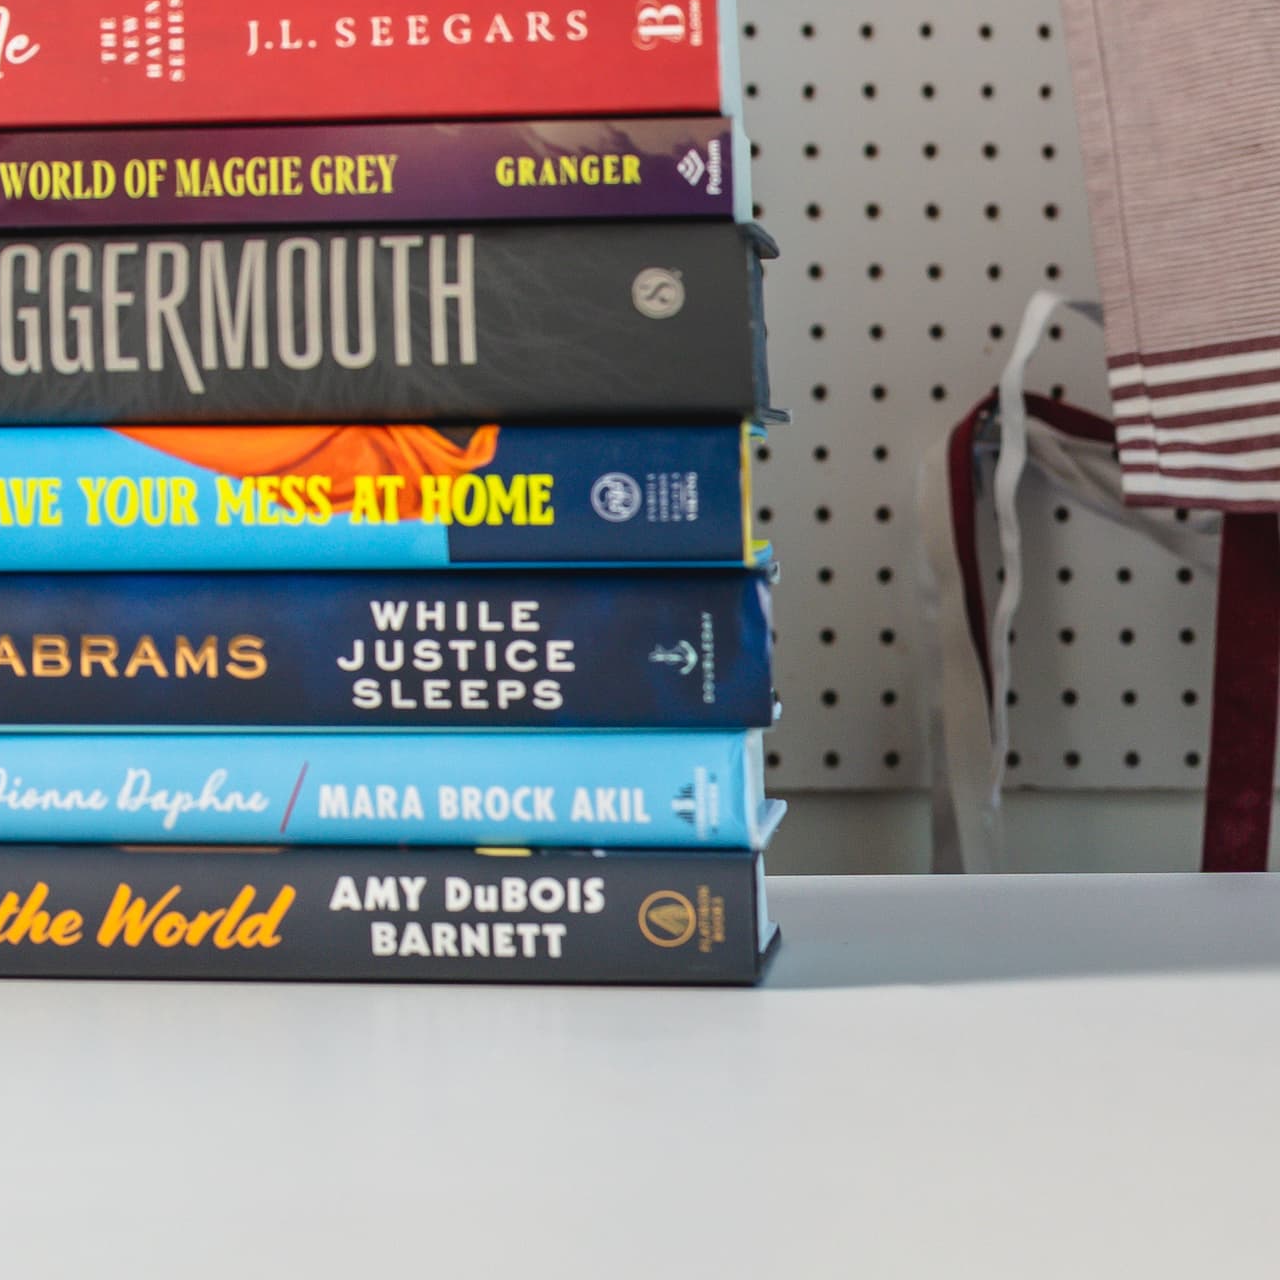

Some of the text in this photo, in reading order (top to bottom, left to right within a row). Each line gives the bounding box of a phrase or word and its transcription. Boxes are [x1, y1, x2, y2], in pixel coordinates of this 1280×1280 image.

[99, 17, 117, 64] THE
[122, 15, 140, 65] NEW
[144, 0, 163, 79] HAVEN
[246, 9, 590, 56] J.L. SEEGARS
[0, 159, 116, 201] WORLD
[123, 158, 168, 198] OF
[175, 156, 303, 198] MAGGIE
[309, 153, 399, 195] GREY
[494, 154, 642, 188] GRANGER
[706, 139, 722, 195] Podium
[78, 477, 200, 527] YOUR
[215, 475, 334, 525] MESS
[350, 473, 406, 524] AT
[420, 472, 555, 526] HOME
[369, 600, 541, 632] WHILE
[336, 639, 576, 673] JUSTICE
[702, 611, 716, 704] DOUBLEDAY
[352, 679, 564, 710] SLEEPS
[117, 768, 271, 830] Daphne
[318, 784, 425, 819] MARA
[437, 785, 558, 821] BROCK
[570, 787, 652, 824] AKIL
[96, 883, 296, 950] World
[329, 876, 606, 915] AMY DuBOIS
[370, 922, 567, 959] BARNETT
